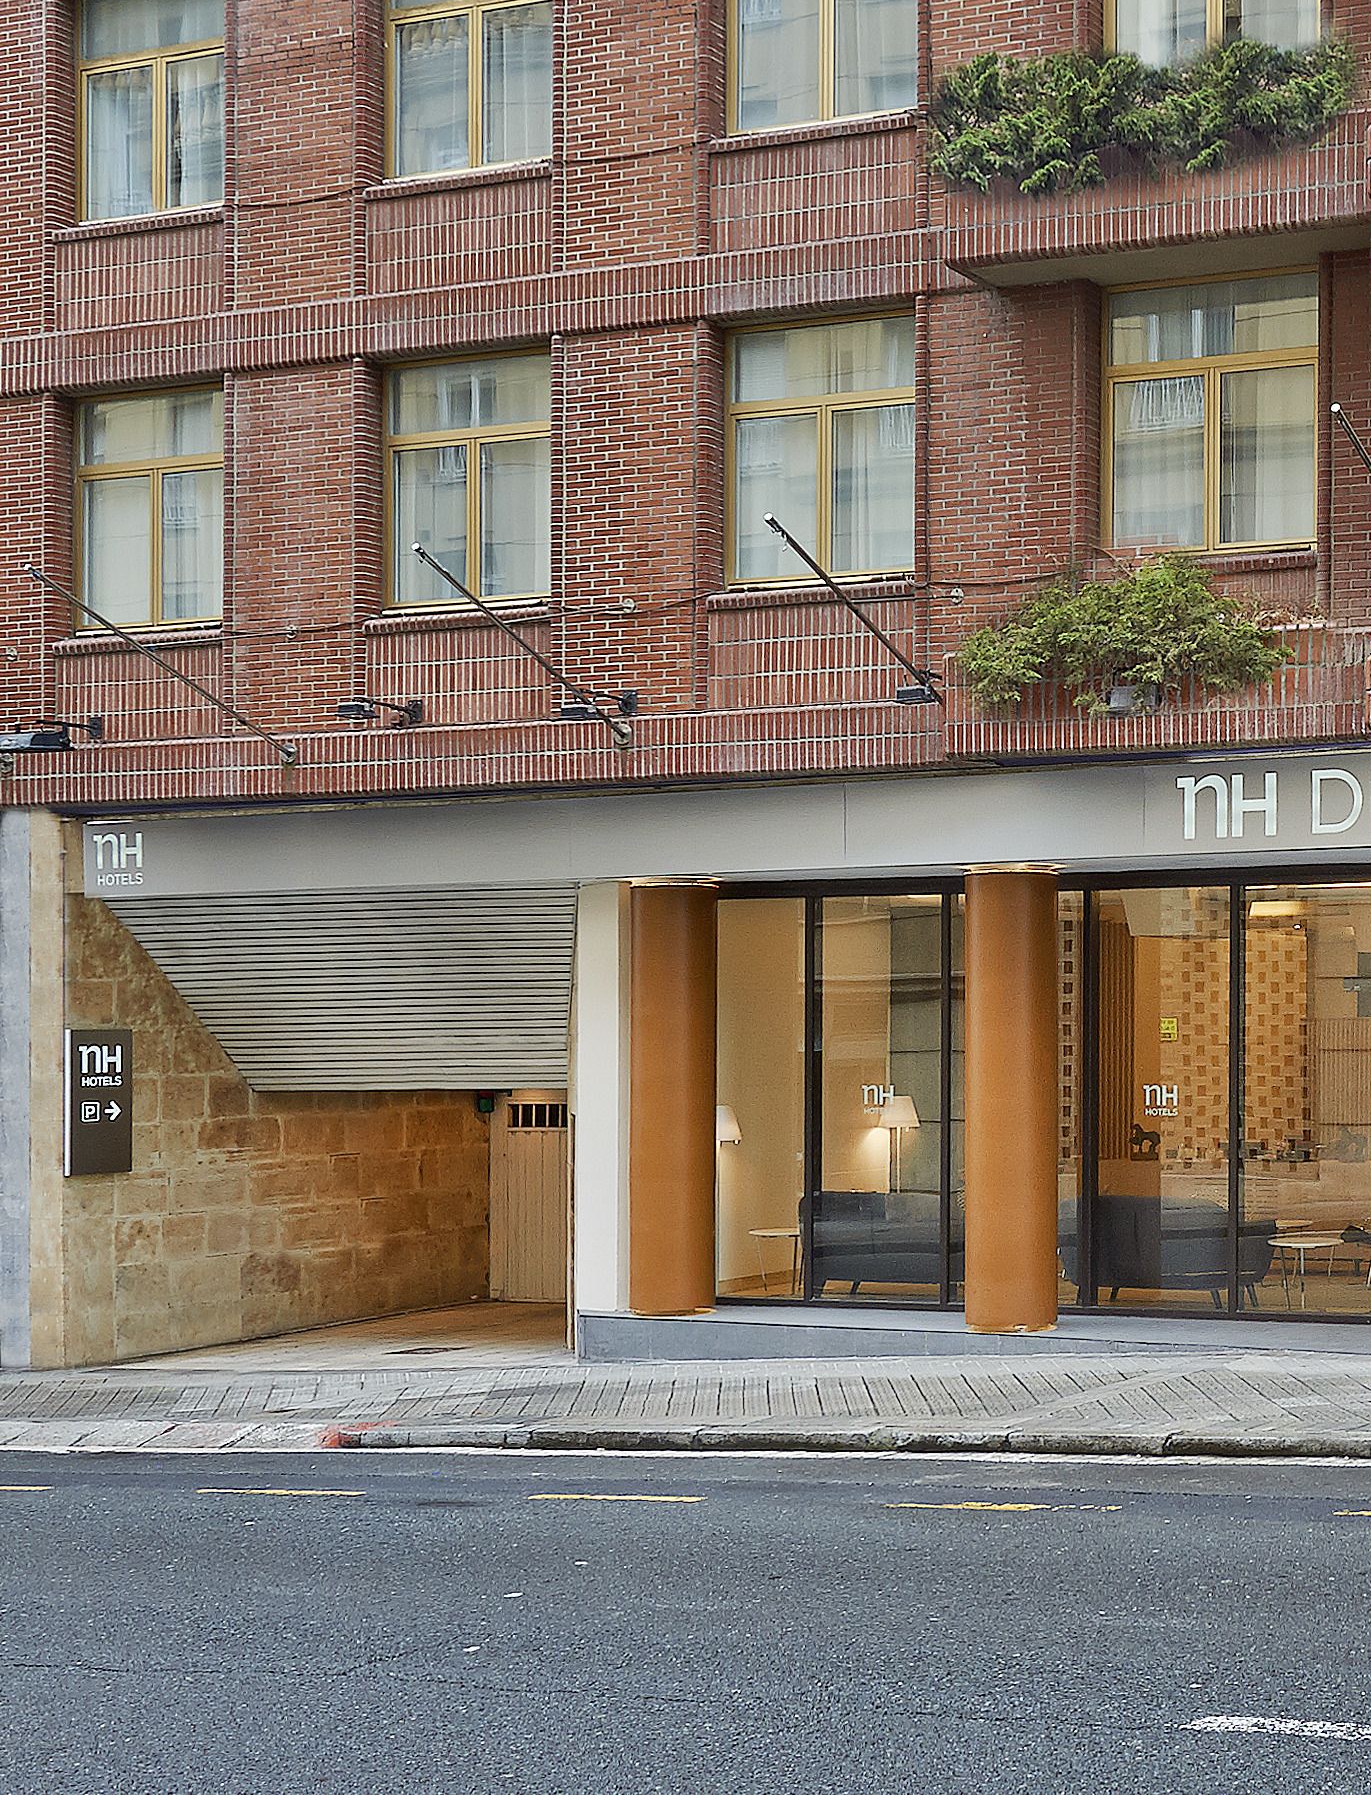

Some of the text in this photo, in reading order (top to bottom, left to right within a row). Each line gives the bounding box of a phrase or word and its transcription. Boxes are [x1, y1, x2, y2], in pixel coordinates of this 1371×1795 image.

[97, 872, 144, 886] HOTELS
[81, 1076, 123, 1087] HOTELS
[1145, 1107, 1179, 1117] HOTELS
